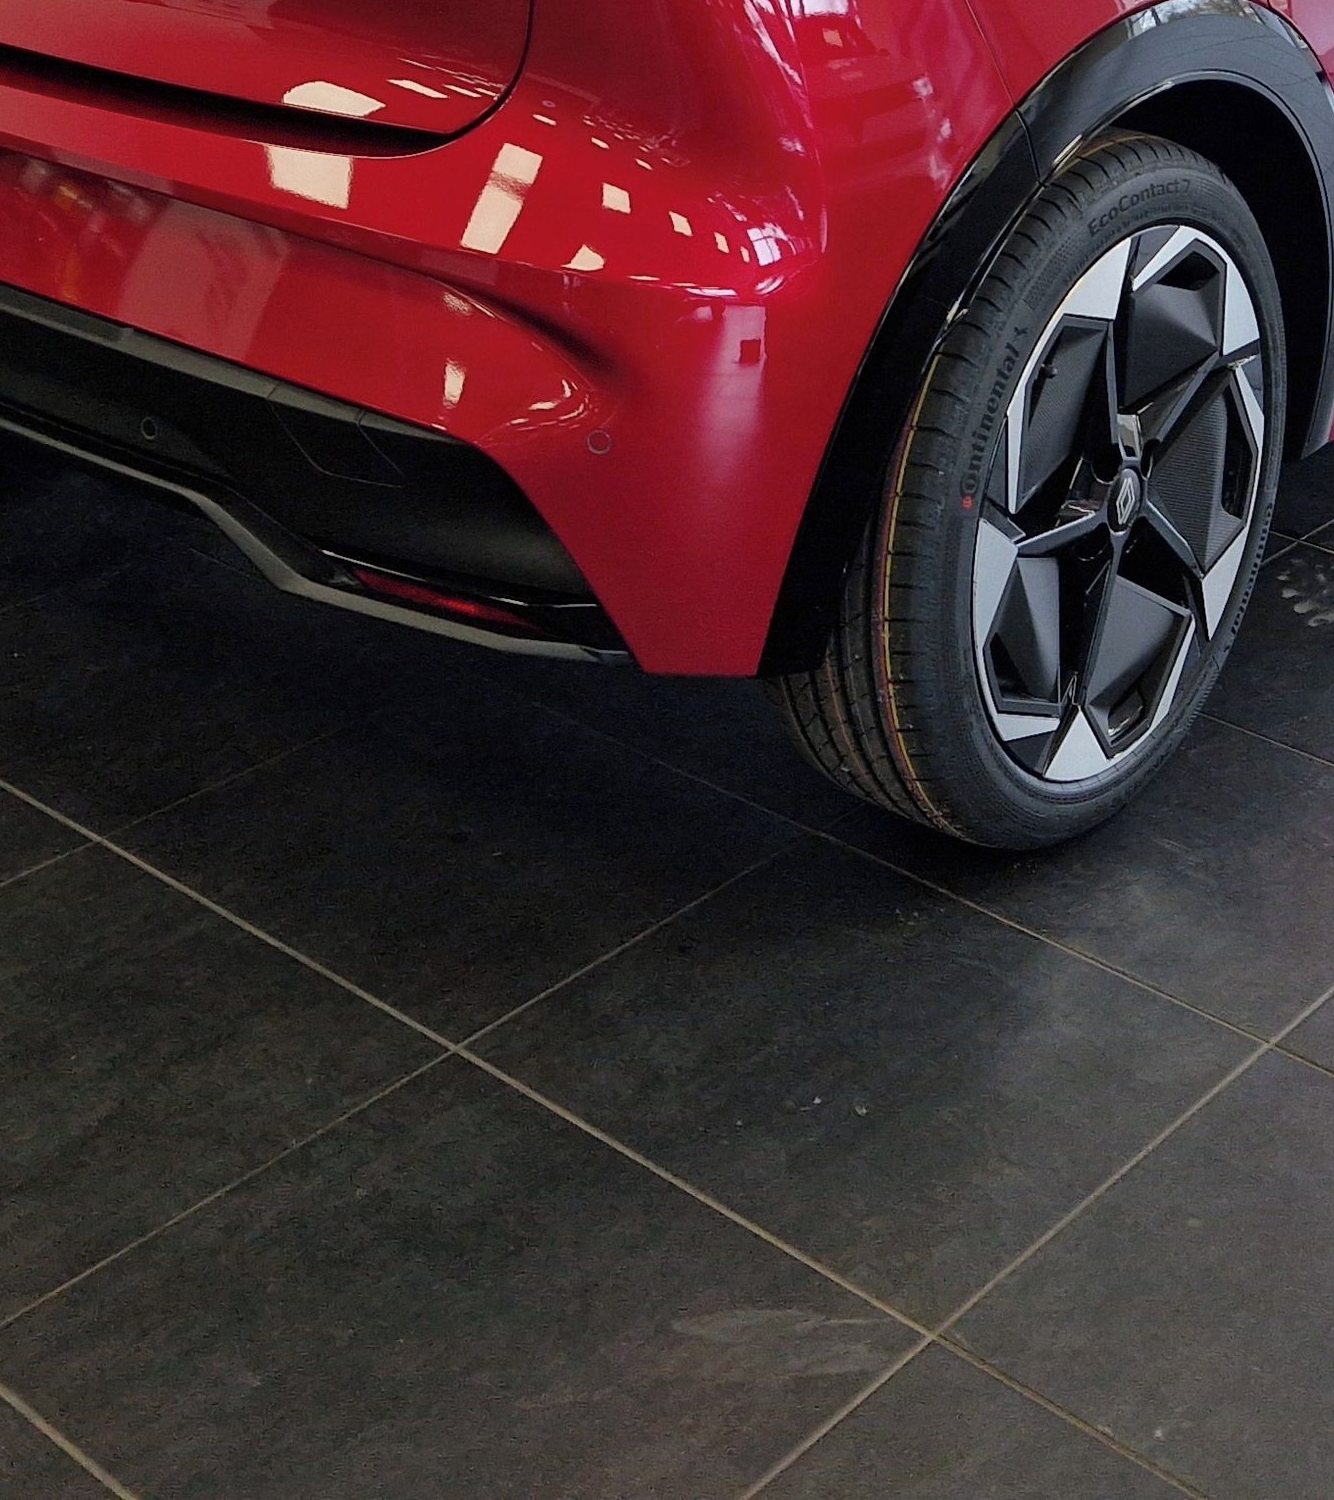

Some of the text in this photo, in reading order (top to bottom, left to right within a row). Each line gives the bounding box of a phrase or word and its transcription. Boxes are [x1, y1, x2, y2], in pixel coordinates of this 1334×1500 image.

[1087, 179, 1180, 237] EcoContact
[1180, 179, 1191, 193] 7
[960, 342, 1020, 499] Continental
